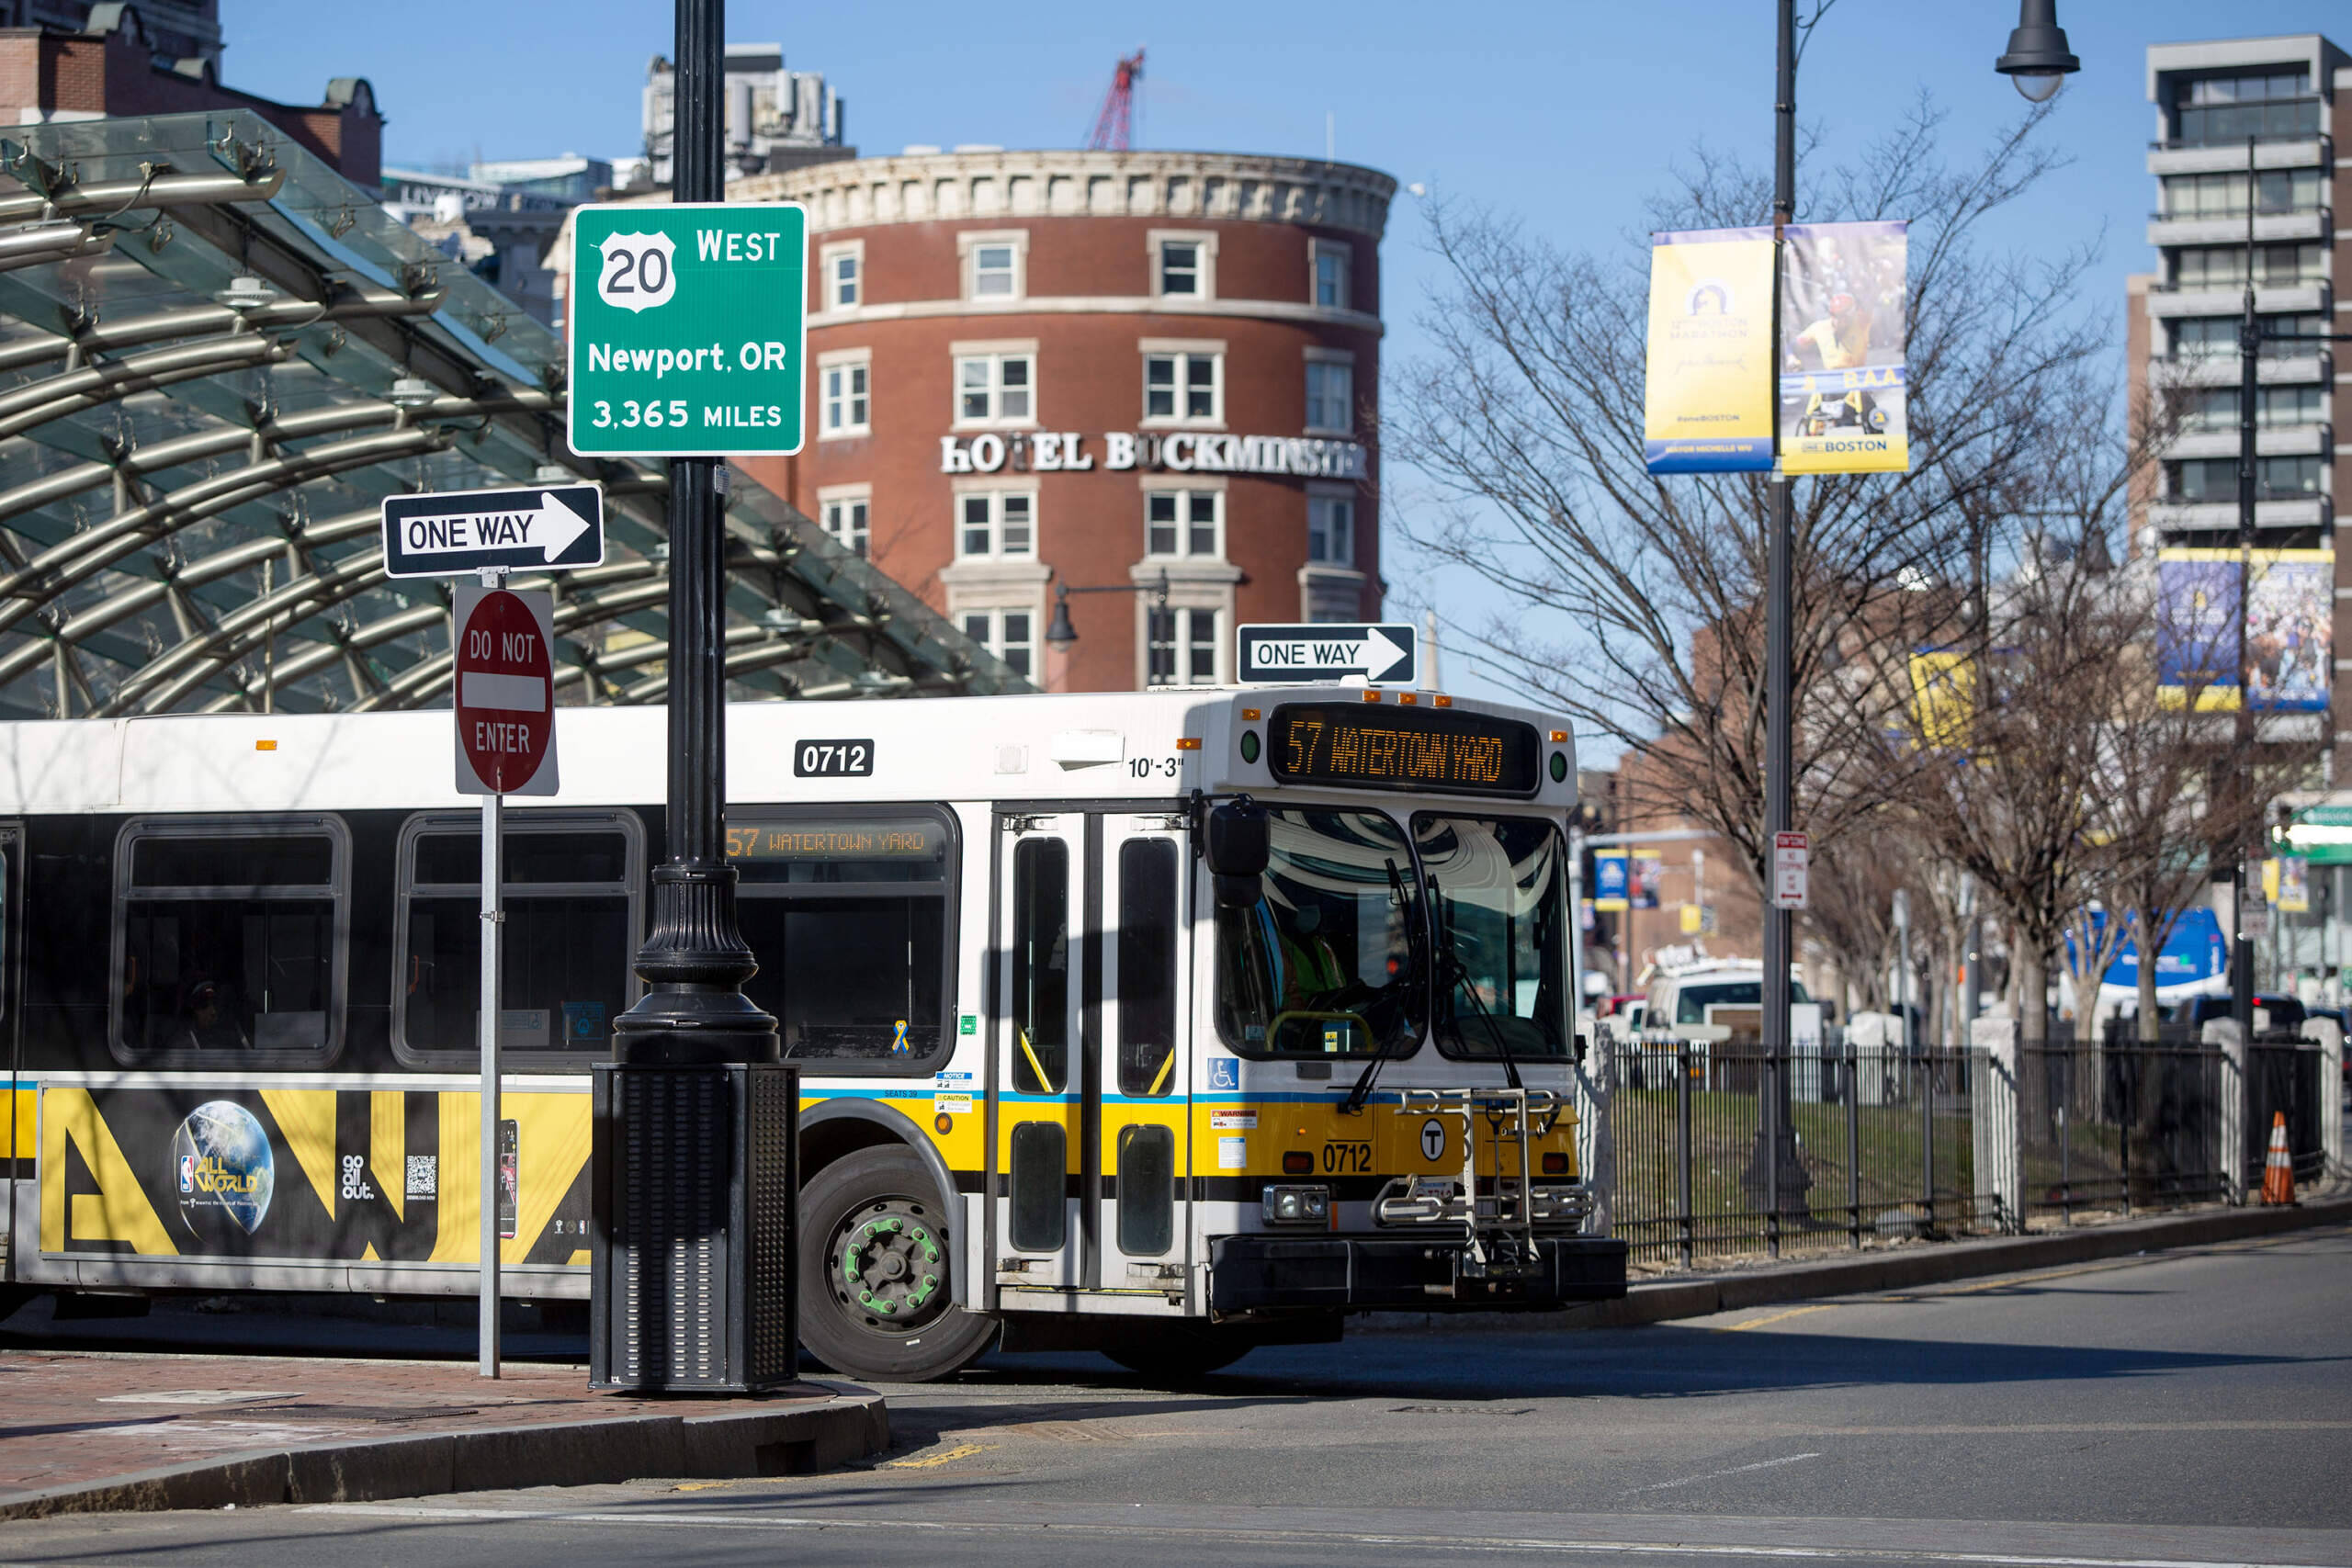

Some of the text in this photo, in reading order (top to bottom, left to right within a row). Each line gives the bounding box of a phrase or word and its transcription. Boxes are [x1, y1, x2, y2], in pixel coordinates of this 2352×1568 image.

[696, 229, 781, 262] WEST
[606, 248, 668, 294] 20
[589, 342, 786, 379] Newport, OR
[1844, 368, 1903, 388] B.A.A.
[592, 400, 782, 430] 3,365 MILES
[1825, 441, 1888, 452] BOSTON
[409, 514, 535, 549] ONE WAY
[470, 630, 536, 663] DO NOT
[1258, 644, 1361, 665] ONE WAY
[476, 721, 530, 753] ENTER
[1286, 721, 1503, 781] 57 WATERTOWN YARD
[802, 745, 866, 773] 0712
[726, 829, 924, 857] 57 WATERTOWN YARD
[1425, 1130, 1441, 1155] T
[195, 1156, 228, 1174] ALL
[343, 1155, 364, 1173] go
[1323, 1144, 1371, 1173] 0712
[195, 1175, 258, 1193] WORLD
[343, 1168, 361, 1186] all
[343, 1182, 375, 1200] out.
